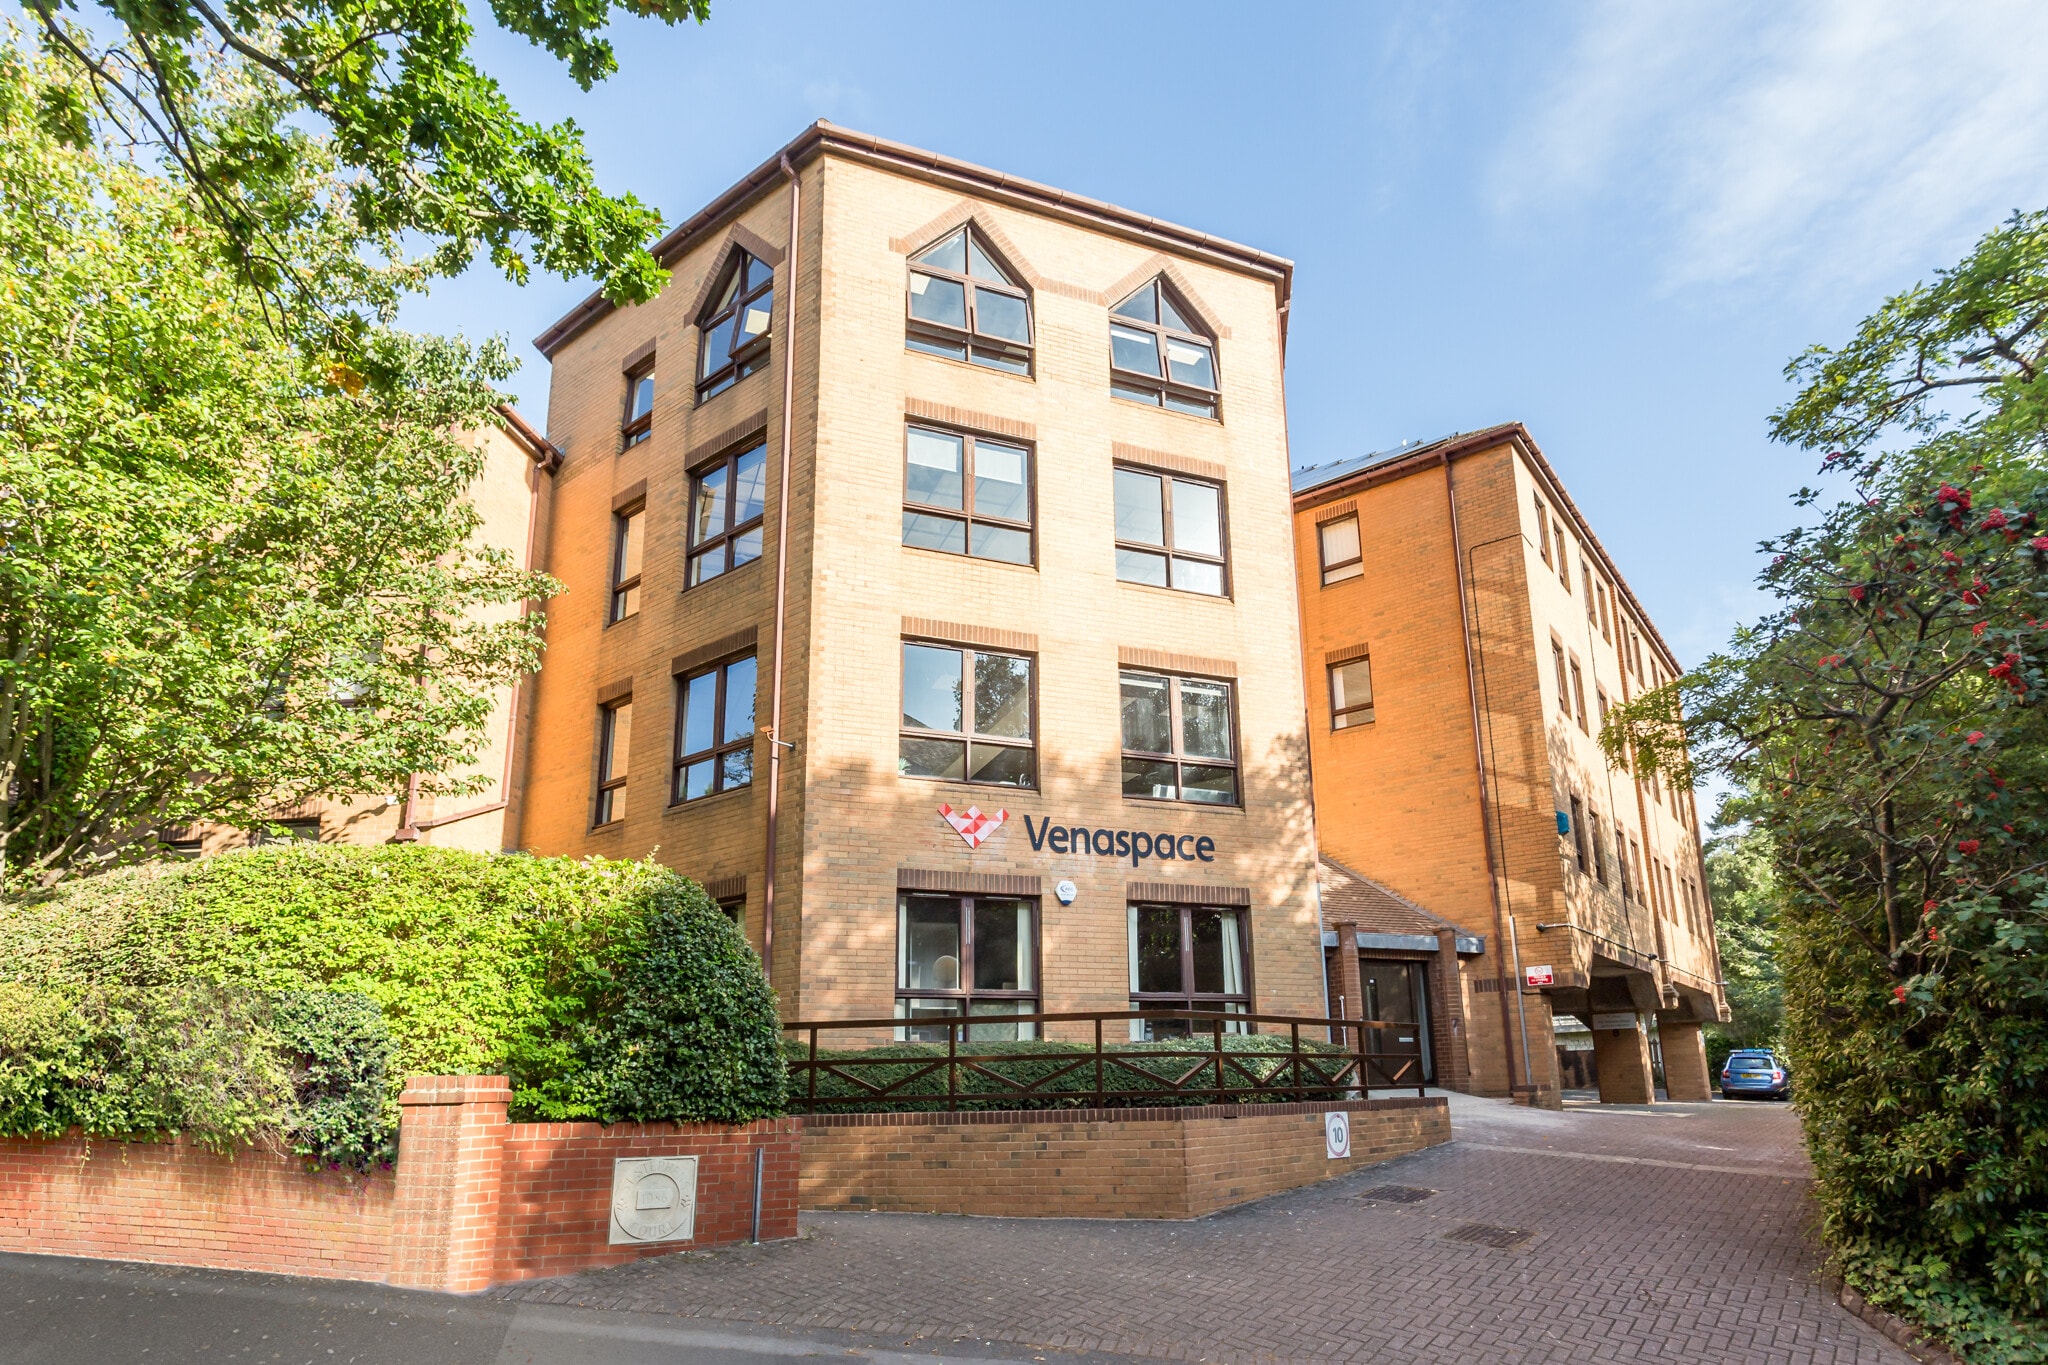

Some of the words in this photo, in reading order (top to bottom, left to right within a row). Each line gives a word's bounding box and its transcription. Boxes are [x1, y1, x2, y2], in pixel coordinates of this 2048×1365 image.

[1024, 815, 1215, 867] Venaspace
[1333, 1127, 1343, 1143] 10
[630, 1221, 676, 1237] COURT
